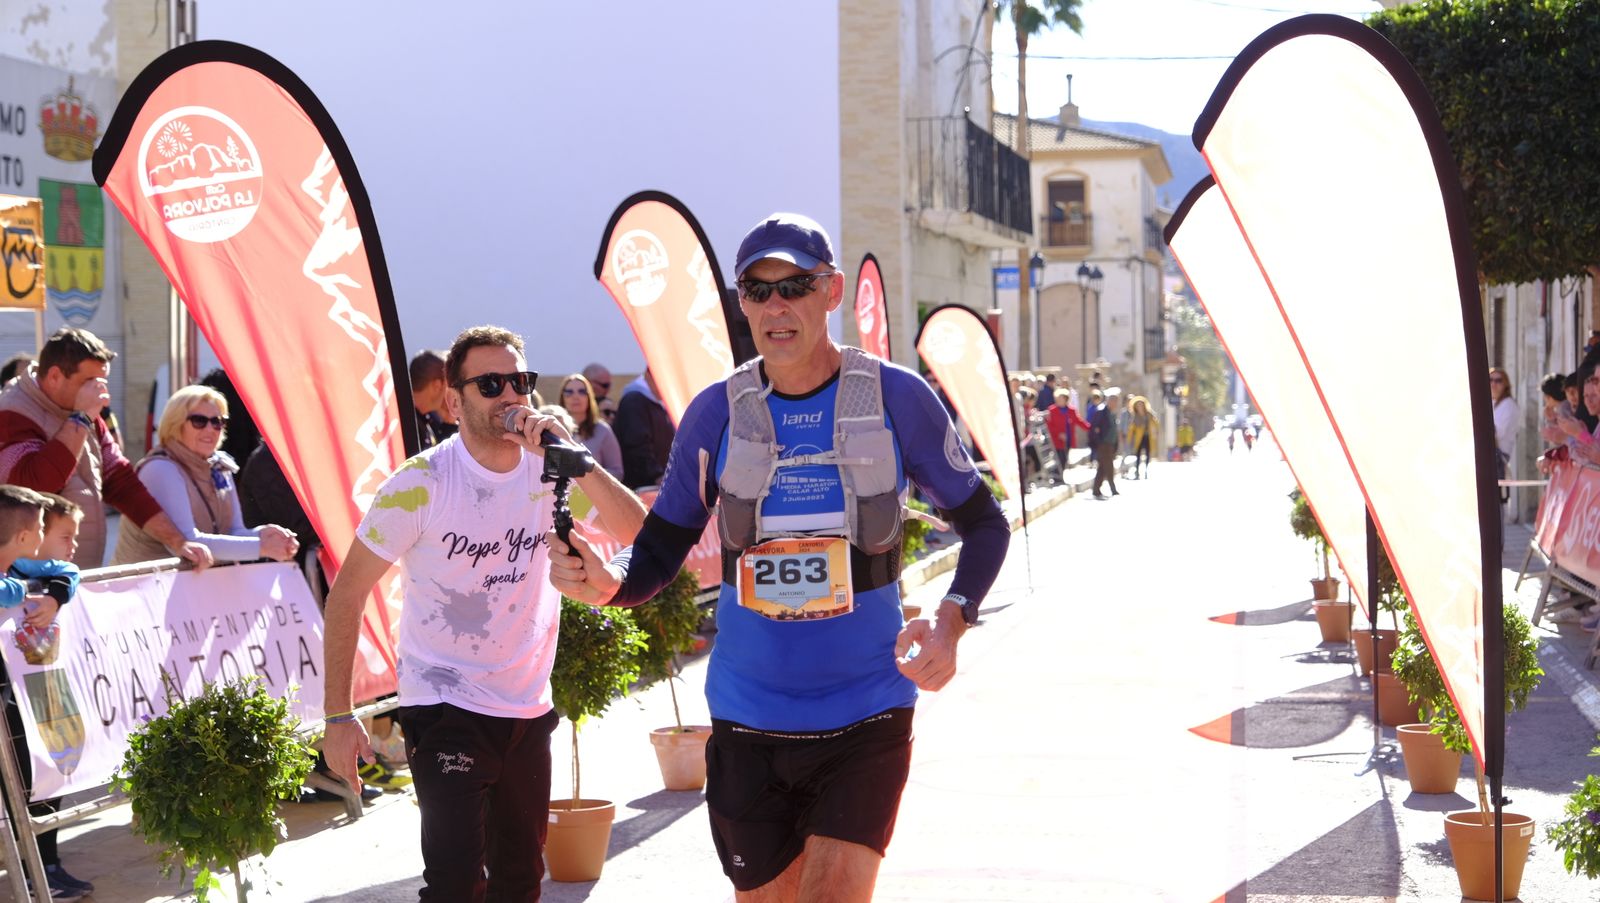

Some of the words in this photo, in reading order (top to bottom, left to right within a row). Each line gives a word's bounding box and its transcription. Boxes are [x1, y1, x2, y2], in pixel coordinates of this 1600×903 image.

[0, 155, 24, 187] TO
[803, 481, 838, 489] MARATON
[442, 531, 503, 568] Pepe
[482, 567, 528, 592] speake
[755, 557, 828, 585] 263
[275, 602, 304, 627] DE
